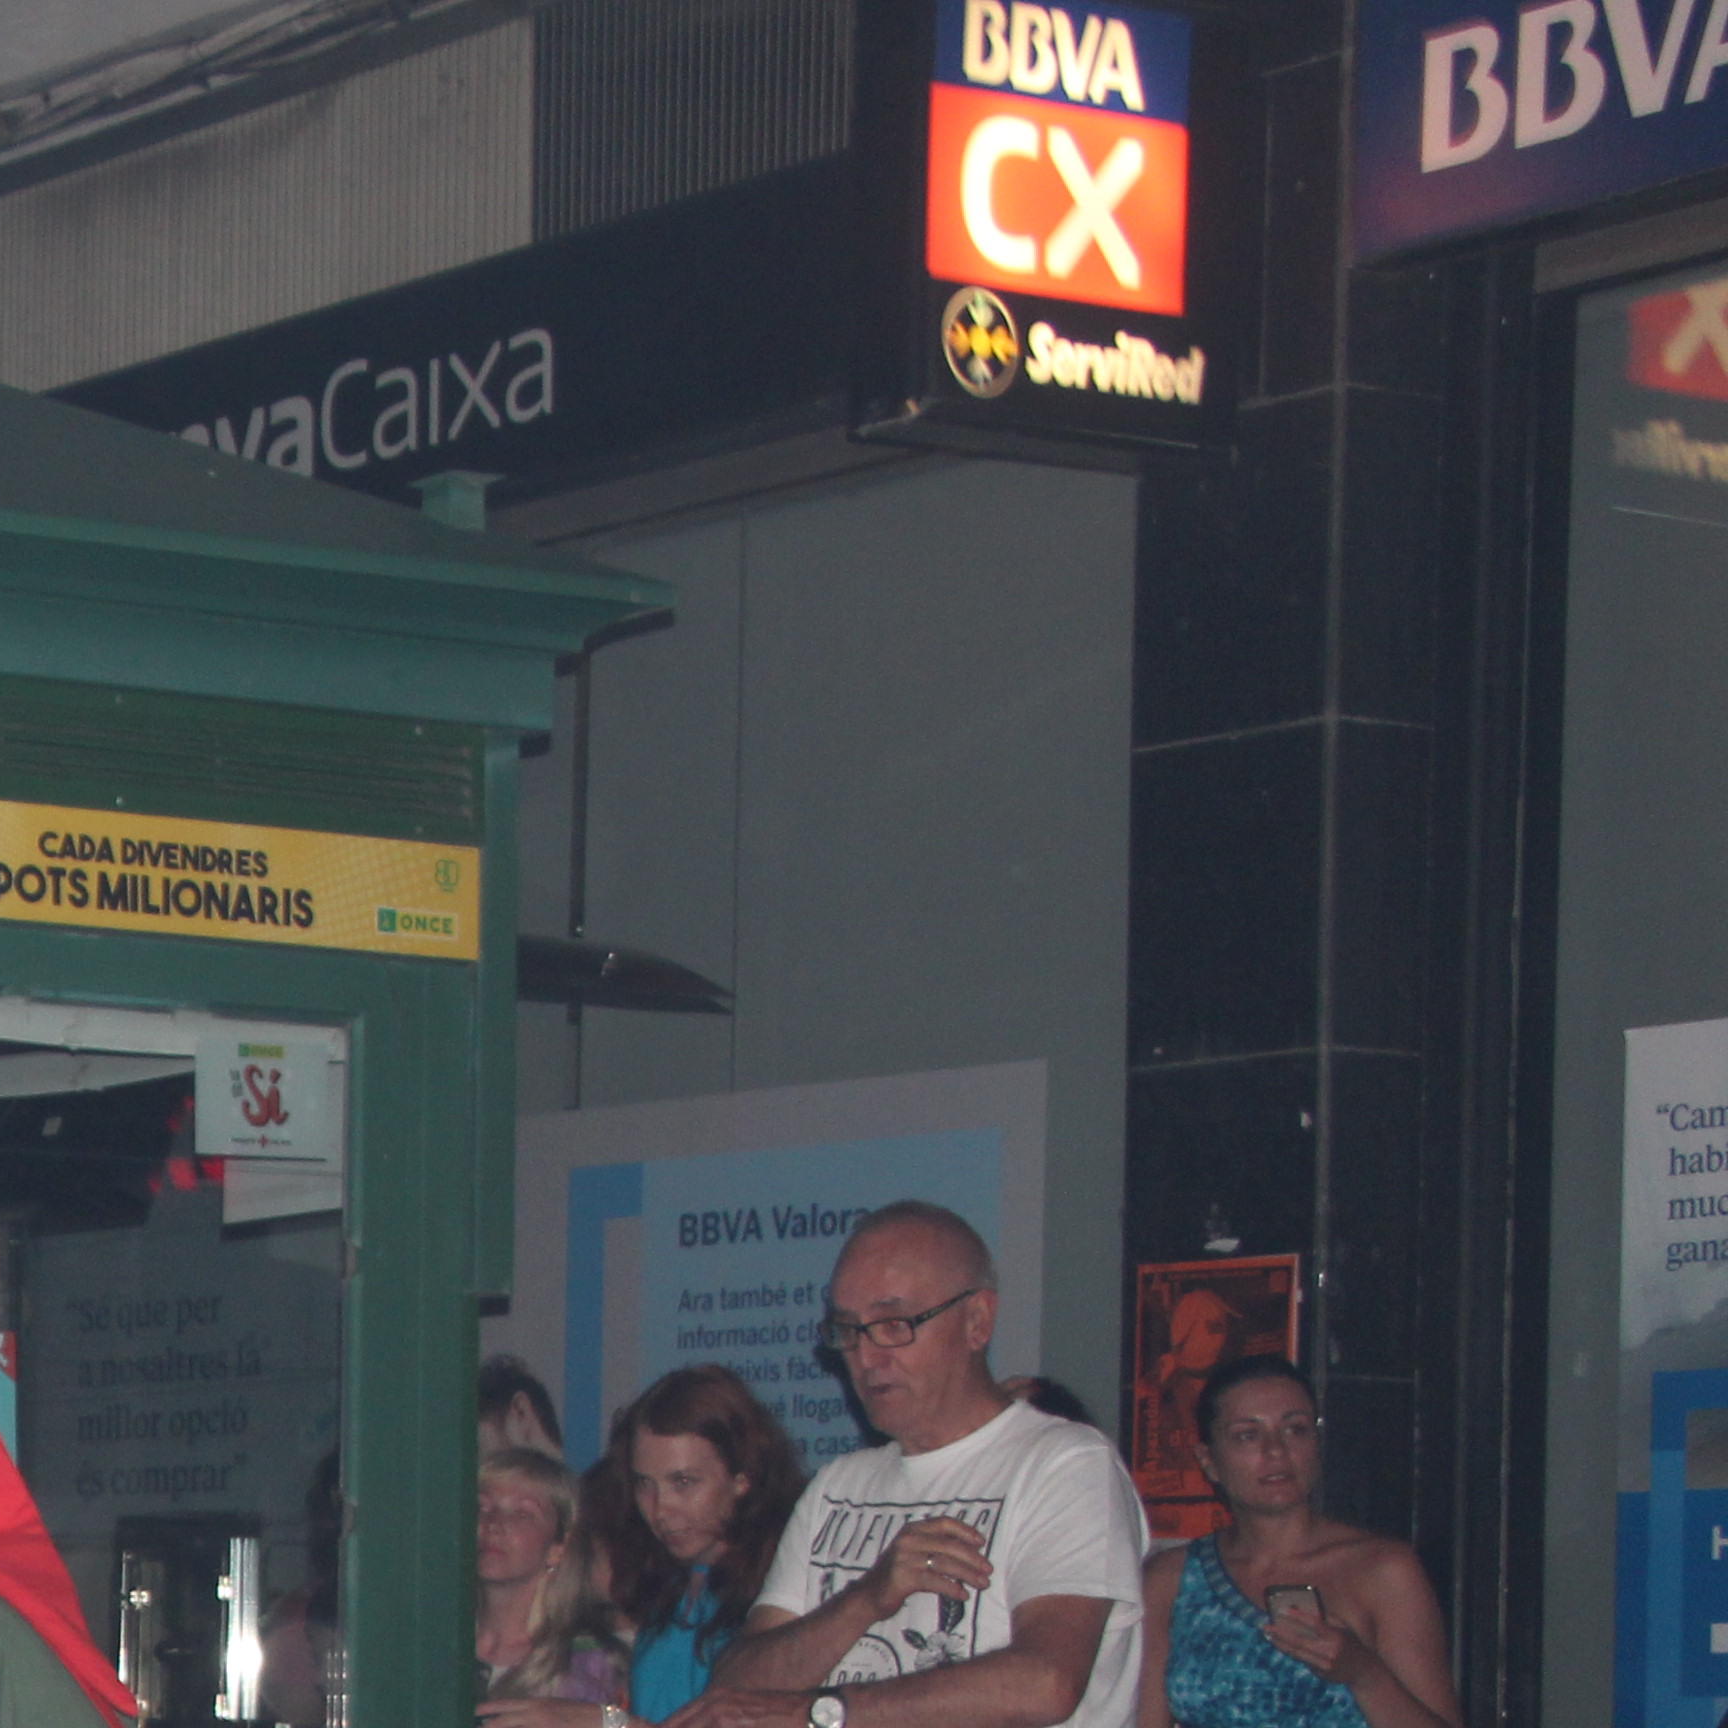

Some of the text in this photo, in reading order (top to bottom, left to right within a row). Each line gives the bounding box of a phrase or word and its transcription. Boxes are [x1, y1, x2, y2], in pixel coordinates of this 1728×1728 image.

[962, 0, 1146, 112] BBVA
[960, 115, 1144, 291] CX
[1025, 321, 1206, 405] ServiRed
[38, 831, 269, 879] CADA DIVENDRES
[96, 871, 314, 929] MILIONARIS
[400, 914, 454, 934] ONCE
[678, 1207, 763, 1248] BBVA
[116, 1298, 168, 1337] que
[175, 1294, 223, 1336] per
[677, 1281, 816, 1314] Ara també et
[676, 1318, 789, 1350] informació
[78, 1403, 163, 1443] millor
